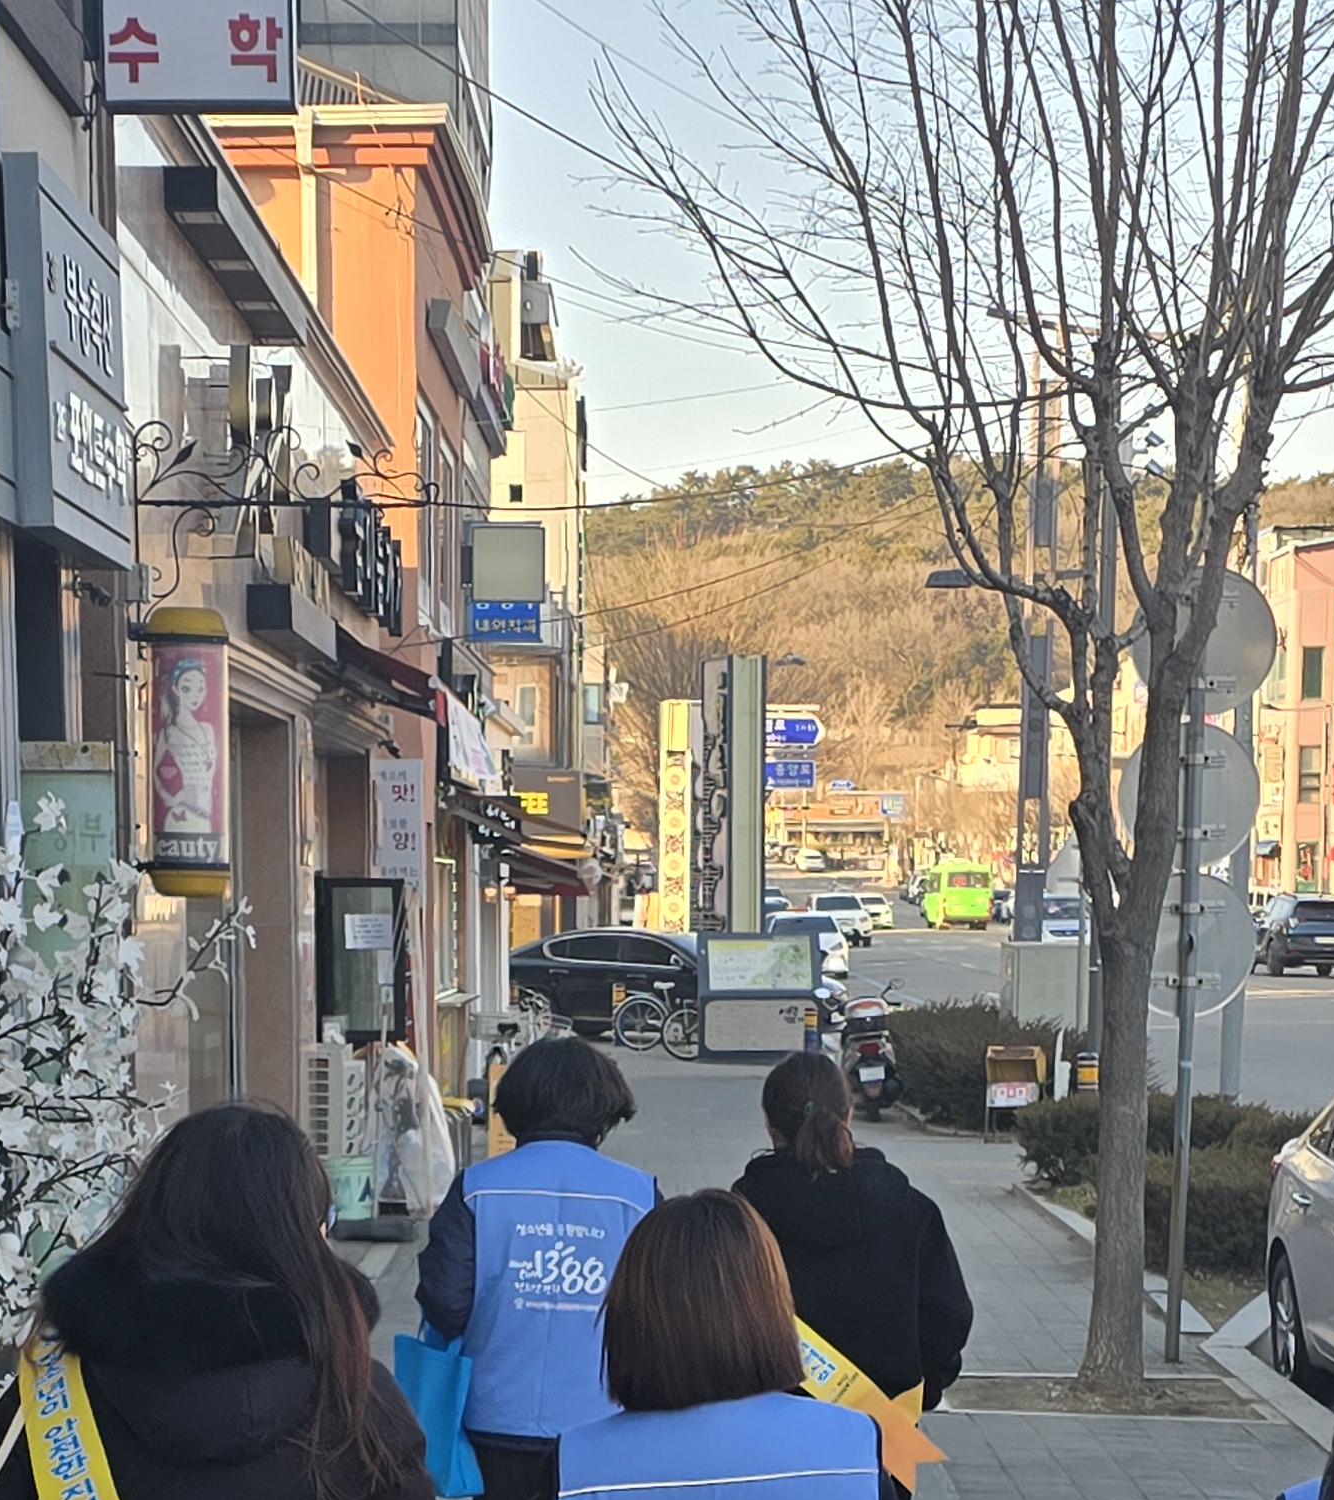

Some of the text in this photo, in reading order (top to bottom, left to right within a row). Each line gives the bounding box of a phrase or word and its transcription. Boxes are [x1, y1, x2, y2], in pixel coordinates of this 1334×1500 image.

[391, 784, 416, 802] 맛!
[154, 837, 219, 861] eauty
[534, 1245, 608, 1295] 1388
[44, 1417, 89, 1482] 안전한
